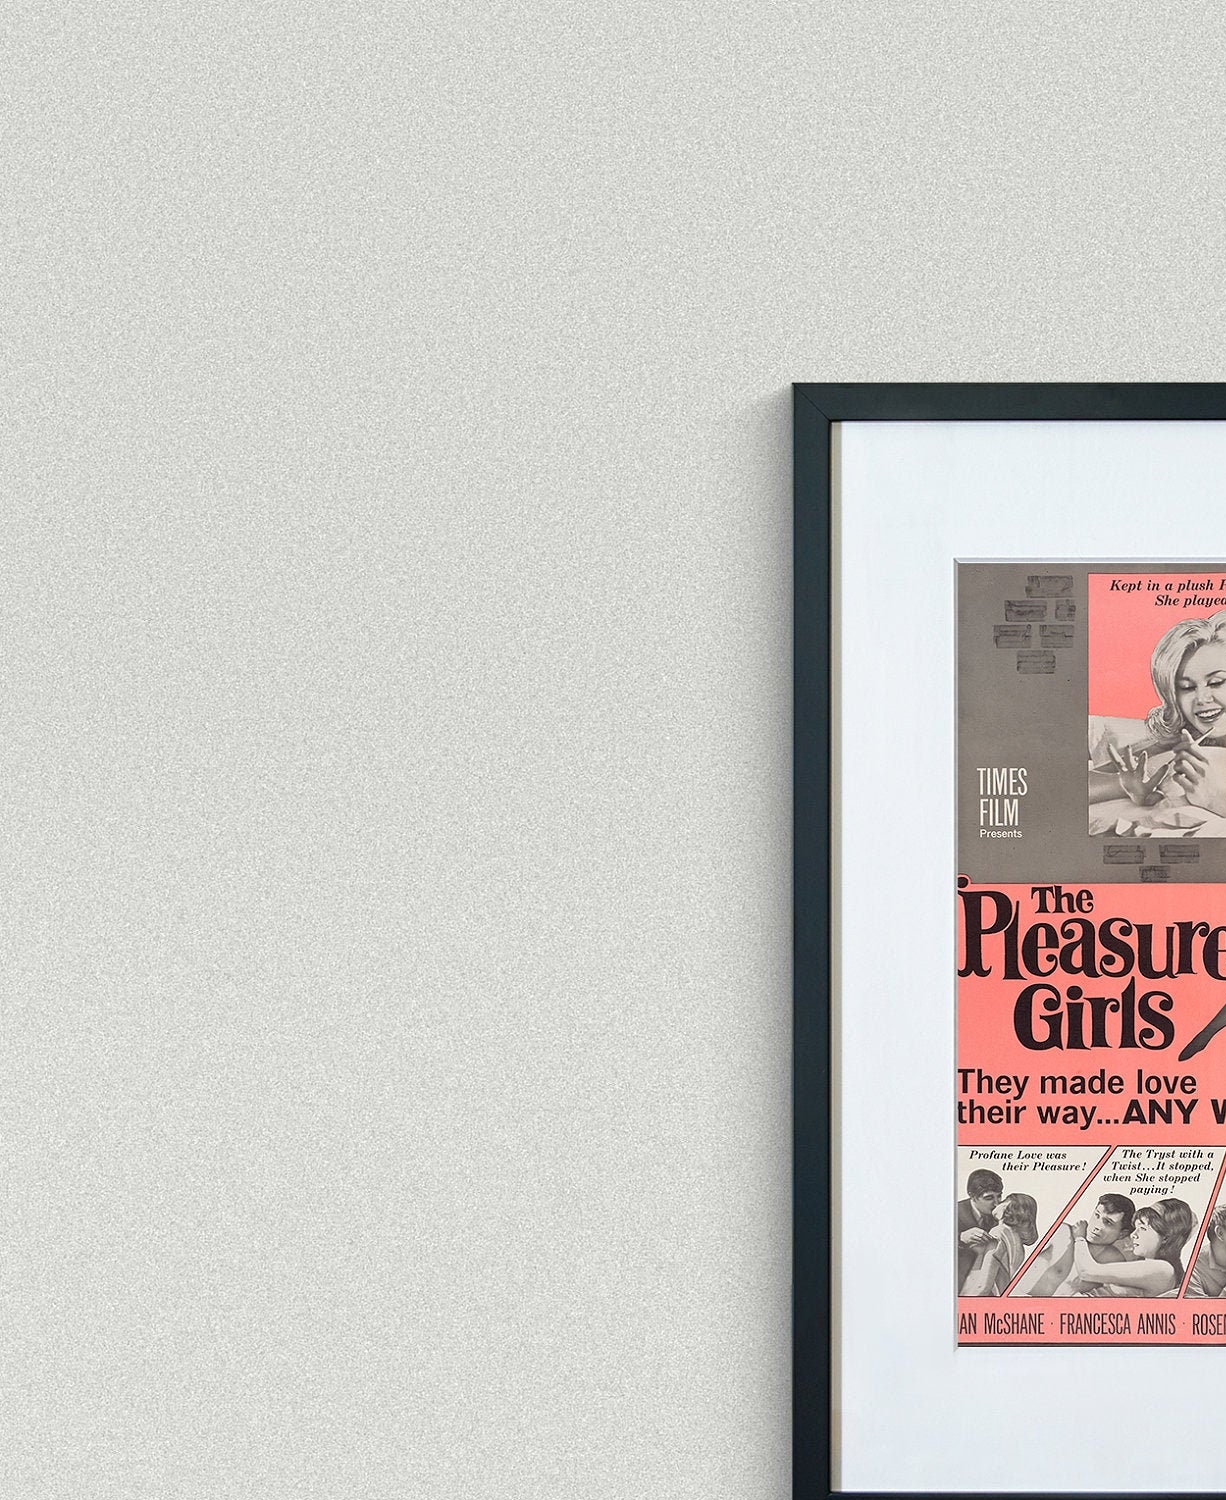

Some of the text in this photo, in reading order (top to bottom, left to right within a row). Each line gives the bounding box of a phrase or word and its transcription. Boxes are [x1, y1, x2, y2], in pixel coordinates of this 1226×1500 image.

[1110, 580, 1143, 594] Kept
[1147, 580, 1161, 592] in
[1165, 583, 1174, 592] a
[1177, 579, 1215, 594] plush
[1155, 594, 1179, 607] She
[977, 767, 1028, 796] TIMES
[980, 798, 1019, 827] FILM
[980, 829, 1023, 838] Presents
[1031, 885, 1093, 913] The
[1014, 976, 1176, 1050] Girls
[957, 1068, 1196, 1101] They made love
[958, 1099, 1026, 1124] their
[969, 1150, 1014, 1162] Profane
[1017, 1150, 1042, 1160] Love
[1122, 1148, 1214, 1162] The Tryst with a
[1002, 1161, 1086, 1172] their Pleasure!
[1169, 1160, 1214, 1174] stopped,
[1103, 1172, 1200, 1184] when She stopped
[1130, 1184, 1174, 1196] paying!
[984, 1313, 1044, 1335] McSHANE
[1060, 1313, 1131, 1335] FRANCESCA
[1137, 1313, 1176, 1335] ANNIS
